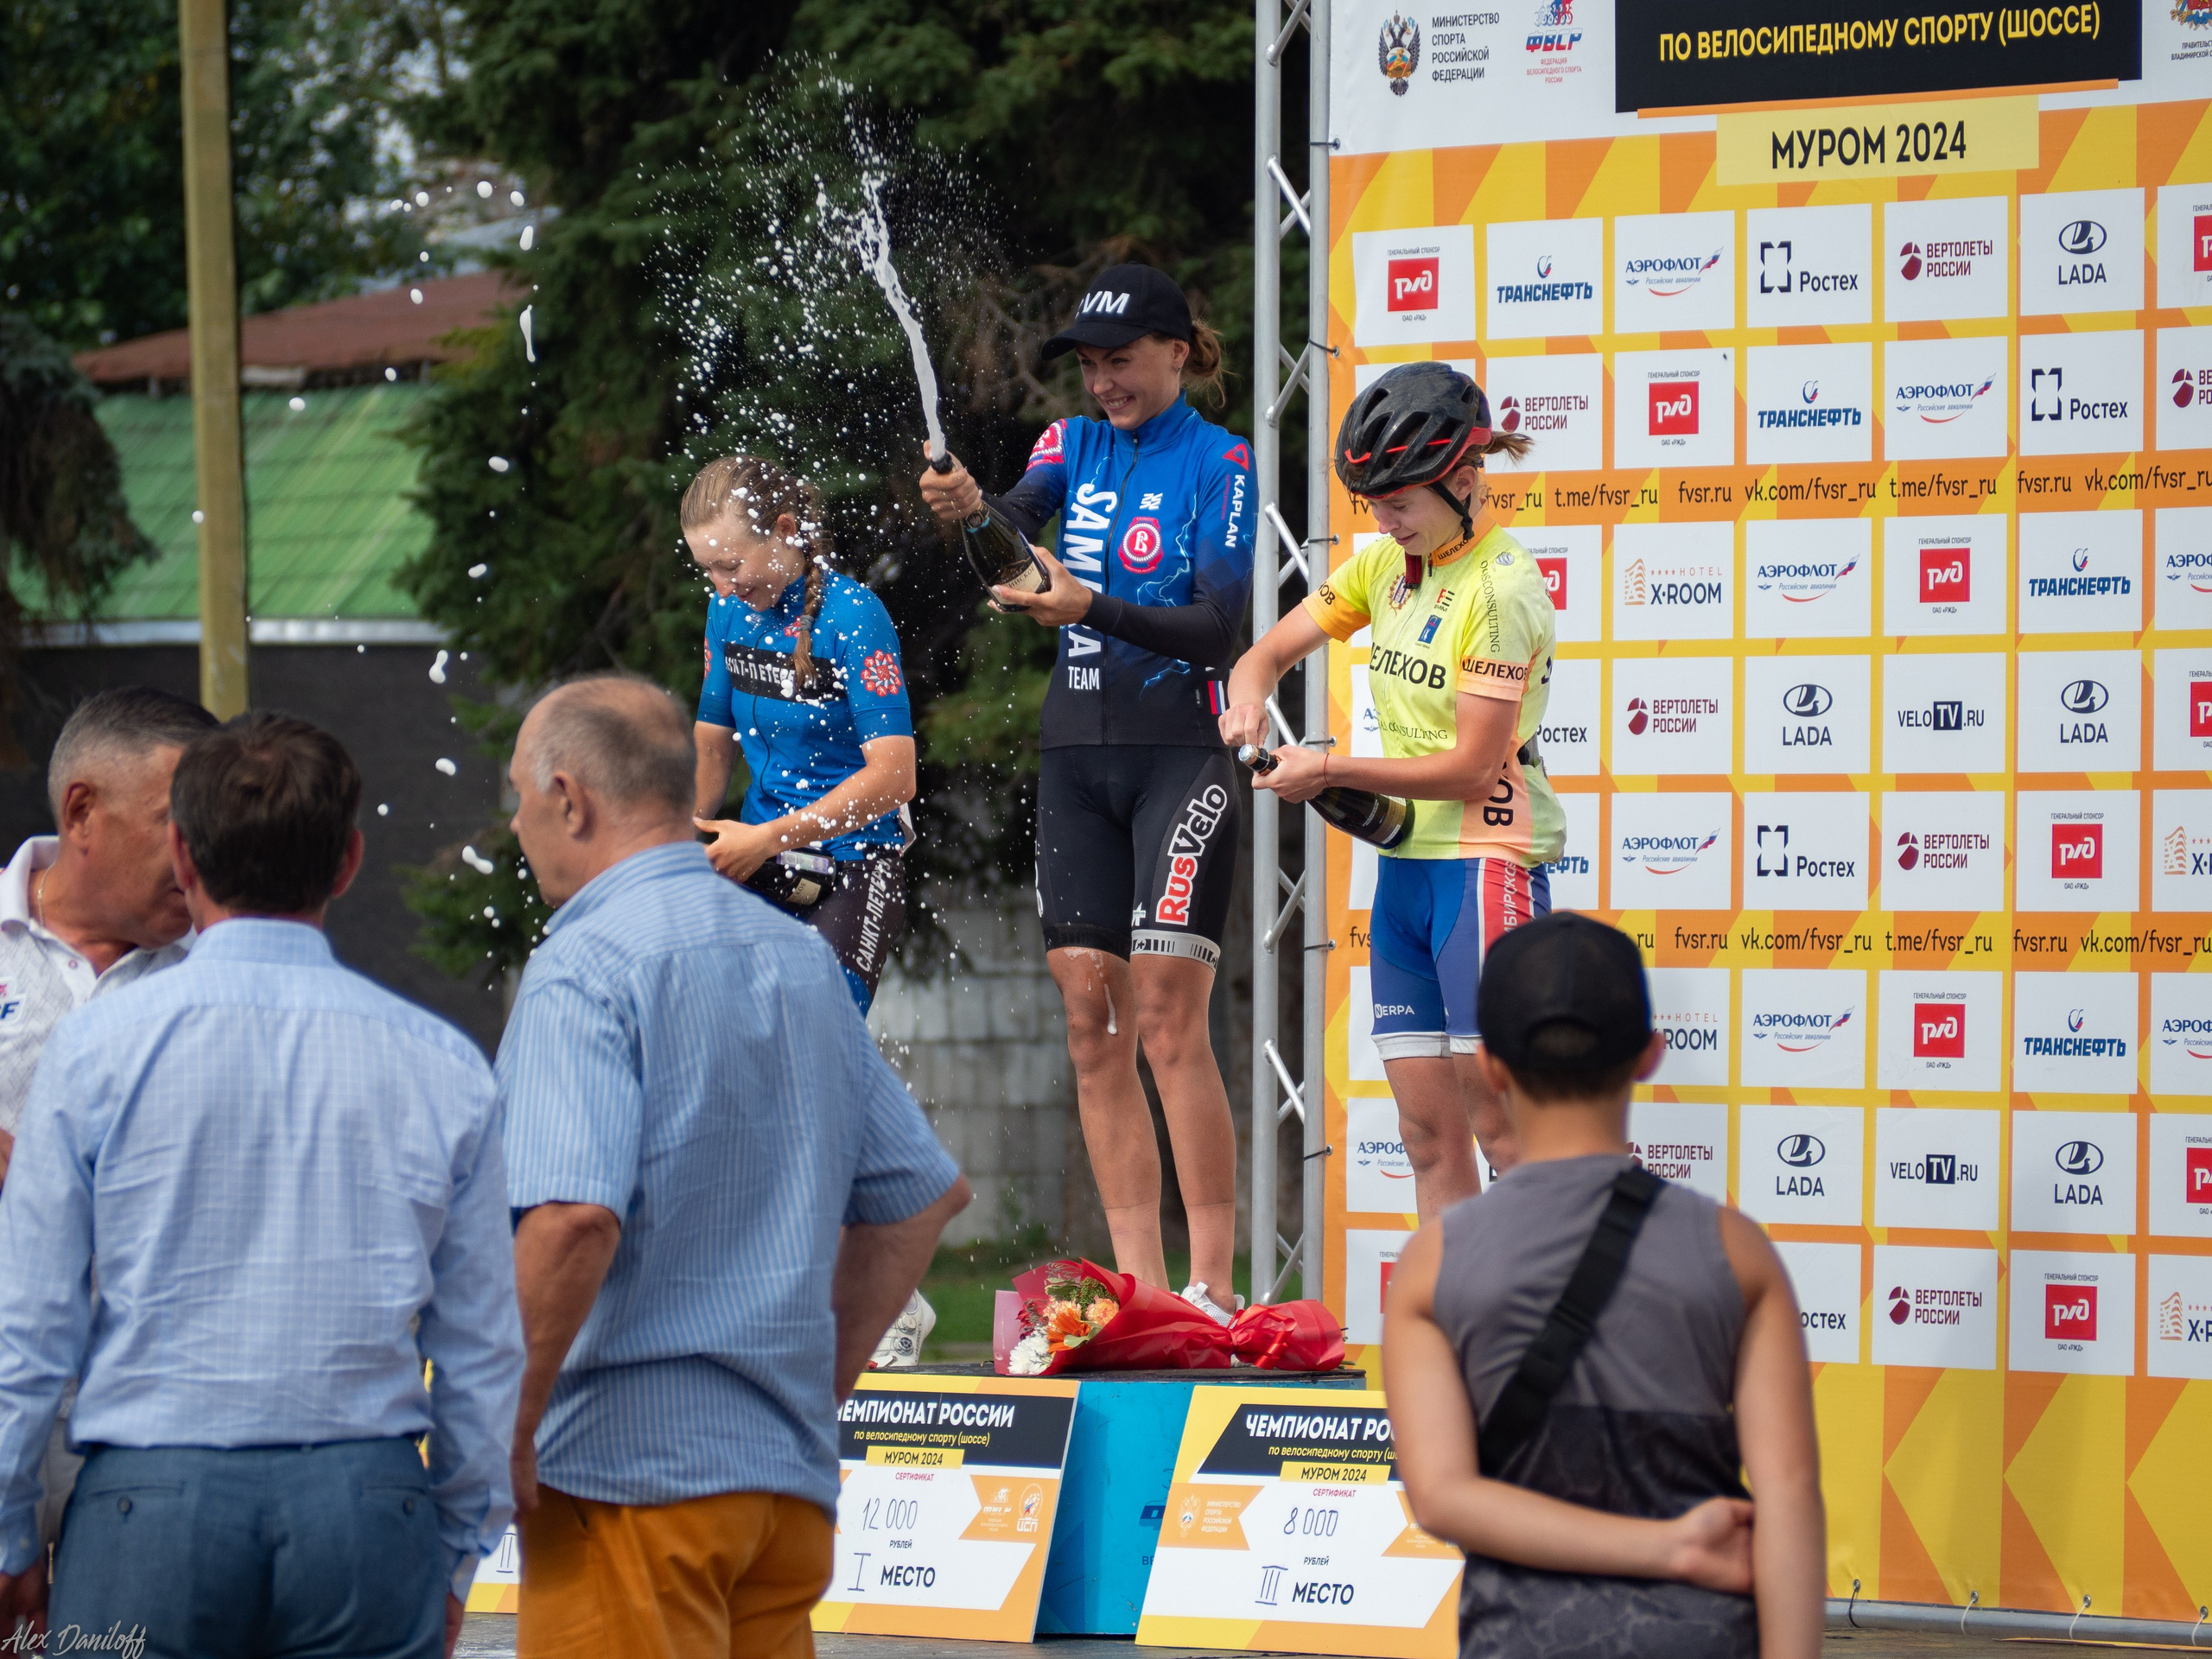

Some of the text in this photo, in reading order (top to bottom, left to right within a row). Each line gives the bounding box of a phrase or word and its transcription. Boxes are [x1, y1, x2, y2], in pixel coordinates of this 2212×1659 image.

[1433, 12, 1499, 28] МИНИСТЕРСТВО
[1432, 33, 1465, 46] СПОРТА
[1660, 1, 2100, 61] ПО ВЕЛОСИПЕДНОМУ СПОРТУ (ШОССЕ)
[1526, 28, 1583, 53] ФВСР
[1433, 46, 1489, 63] РОССИЙСКОЙ
[1541, 57, 1567, 66] ФЕДЕРАЦИЯ
[2171, 49, 2209, 60] ВЛАДИМИРСКОЙ
[1433, 67, 1484, 83] ФЕДЕРАЦИИ
[1527, 67, 1564, 75] ВЕЛОСИПЕДНОГО
[1772, 121, 1966, 168] МУРОМ 2024
[1388, 247, 1420, 256] ГЕНЕРАЛЬНЫЙ
[1927, 240, 1993, 258] ВЕРТОЛЕТЫ
[1626, 257, 1700, 272] АЭРОФЛОТ
[1927, 261, 1970, 277] РОССИИ
[1801, 271, 1858, 292] Ростех
[2059, 264, 2107, 285] LADA
[1497, 283, 1592, 303] ТРАНСНЕФТЬ
[1648, 370, 1679, 378] ГЕНЕРАЛЬНЫЙ
[1897, 385, 1977, 400] АЭРОФЛОТ
[1525, 396, 1588, 411] ВЕРТОЛЕТЫ
[2070, 398, 2127, 420] Ростех
[1525, 415, 1567, 430] РОССИИ
[1758, 408, 1861, 428] ТРАНСНЕФТЬ
[1555, 484, 1658, 507] t.me/fvsr_ru
[1679, 481, 1732, 503] fvsr.ru
[1745, 477, 1877, 501] vk.com/fvsr_ru
[1890, 474, 1997, 498] t.me/fvsr_ru
[2018, 471, 2071, 493] fvsr.ru
[1224, 474, 1245, 548] KAPLAN
[1063, 483, 1117, 657] SAMA
[1680, 567, 1722, 576] HOTEL
[1758, 564, 1840, 581] АЭРОФЛОТ
[2029, 576, 2130, 596] ТРАНСНЕФТЬ
[1370, 642, 1446, 690] ЕЛЕХОВ
[1068, 666, 1100, 690] TEAM
[1654, 699, 1718, 714] ВЕРТОЛЕТЫ
[1653, 718, 1696, 733] РОССИИ
[2061, 723, 2108, 743] LADA
[1783, 727, 1832, 746] LADA
[1623, 837, 1702, 853] АЭРОФЛОТ
[1924, 835, 1989, 849] ВЕРТОЛЕТЫ
[1797, 856, 1854, 877] Ростех
[1924, 854, 1967, 868] РОССИИ
[1675, 926, 1728, 949] fvsr.ru
[1741, 927, 1872, 953] vk.com/fvsr_ru
[1885, 929, 1993, 954] t.me/fvsr_ru
[2013, 929, 2067, 952] fvsr.ru
[2081, 930, 2212, 956] vk.com/fvsr_ru
[1374, 1003, 1415, 1019] NERPA
[1675, 1013, 1718, 1022] HOTEL
[1753, 1014, 1835, 1031] АЭРОФЛОТ
[2024, 1038, 2126, 1057] ТРАНСНЕФТЬ
[1648, 1145, 1713, 1160] ВЕРТОЛЕТЫ
[1648, 1163, 1691, 1179] РОССИИ
[1777, 1176, 1824, 1196] LADA
[2055, 1184, 2103, 1205] LADA
[1916, 1289, 1982, 1306] ВЕРТОЛЕТЫ
[1800, 1311, 1847, 1330] остех
[1916, 1308, 1960, 1325] РОССИИ
[938, 1403, 1015, 1427] РОССИИ
[1245, 1414, 1362, 1440] ЧЕМПИОНАТ
[854, 1431, 989, 1446] по велосипедному спорту (шоссе)
[885, 1452, 943, 1465] МУРОМ 2024
[1268, 1446, 1280, 1455] по
[1281, 1447, 1350, 1461] велосипедному
[1351, 1450, 1382, 1462] спорту
[895, 1472, 934, 1481] СЕРТИФИКАТ
[1301, 1467, 1367, 1481] МУРОМ 2024
[1313, 1489, 1357, 1497] СЕРТИФИКАТ
[863, 1497, 918, 1530] 12 000
[1283, 1507, 1299, 1535] 8
[890, 1539, 912, 1548] РУБЛЕЙ
[1304, 1556, 1329, 1566] РУБЛЕЙ
[880, 1566, 935, 1587] МЕСТО
[1293, 1582, 1354, 1605] МЕСТО
